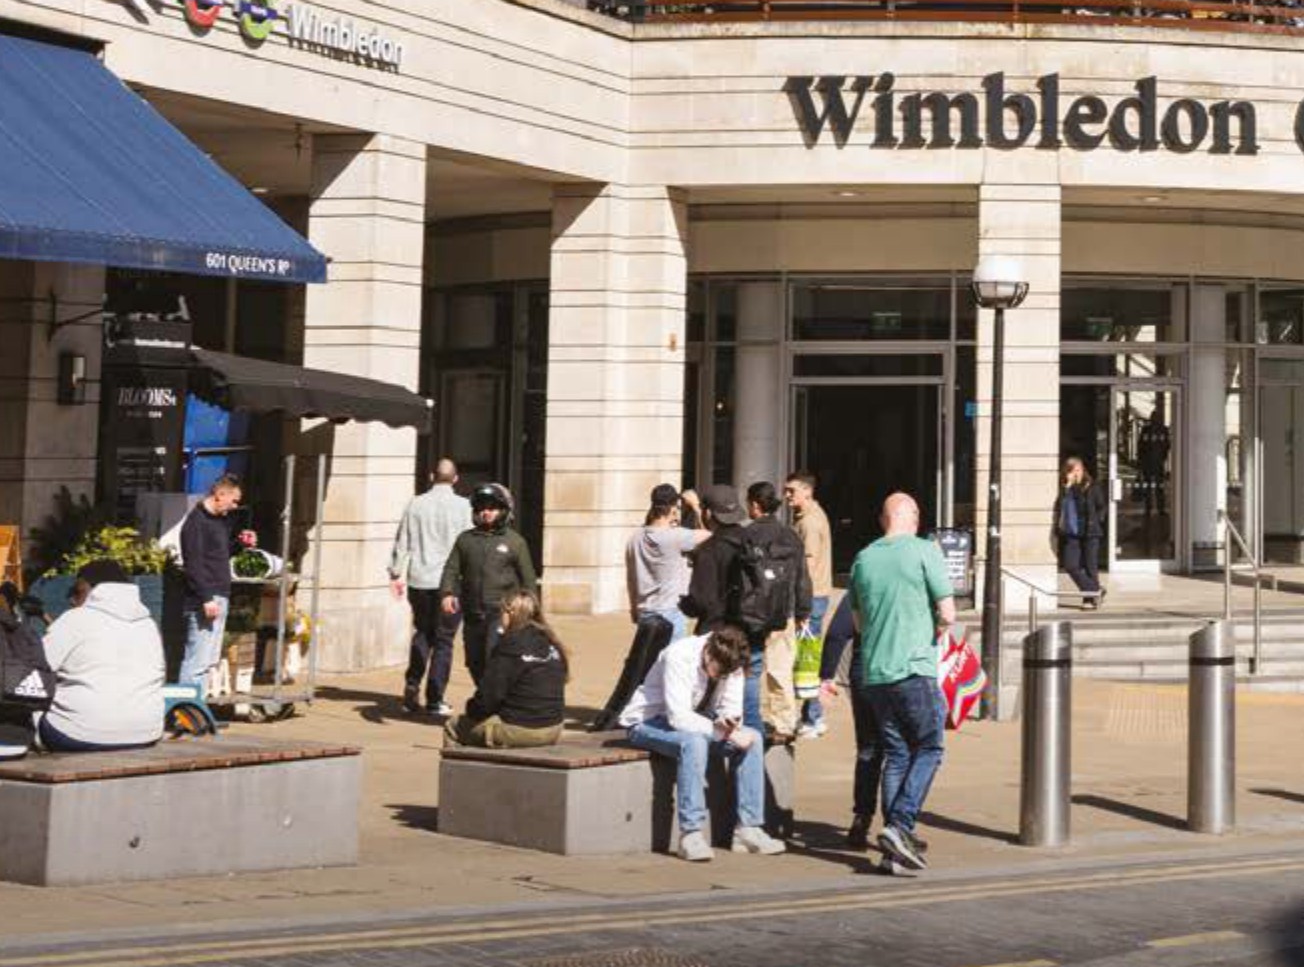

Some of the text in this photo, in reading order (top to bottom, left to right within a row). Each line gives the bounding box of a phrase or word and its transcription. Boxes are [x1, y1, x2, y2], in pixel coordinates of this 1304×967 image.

[287, 4, 403, 65] Wimbledon
[780, 71, 1260, 156] Wimbledon
[206, 252, 226, 269] 601
